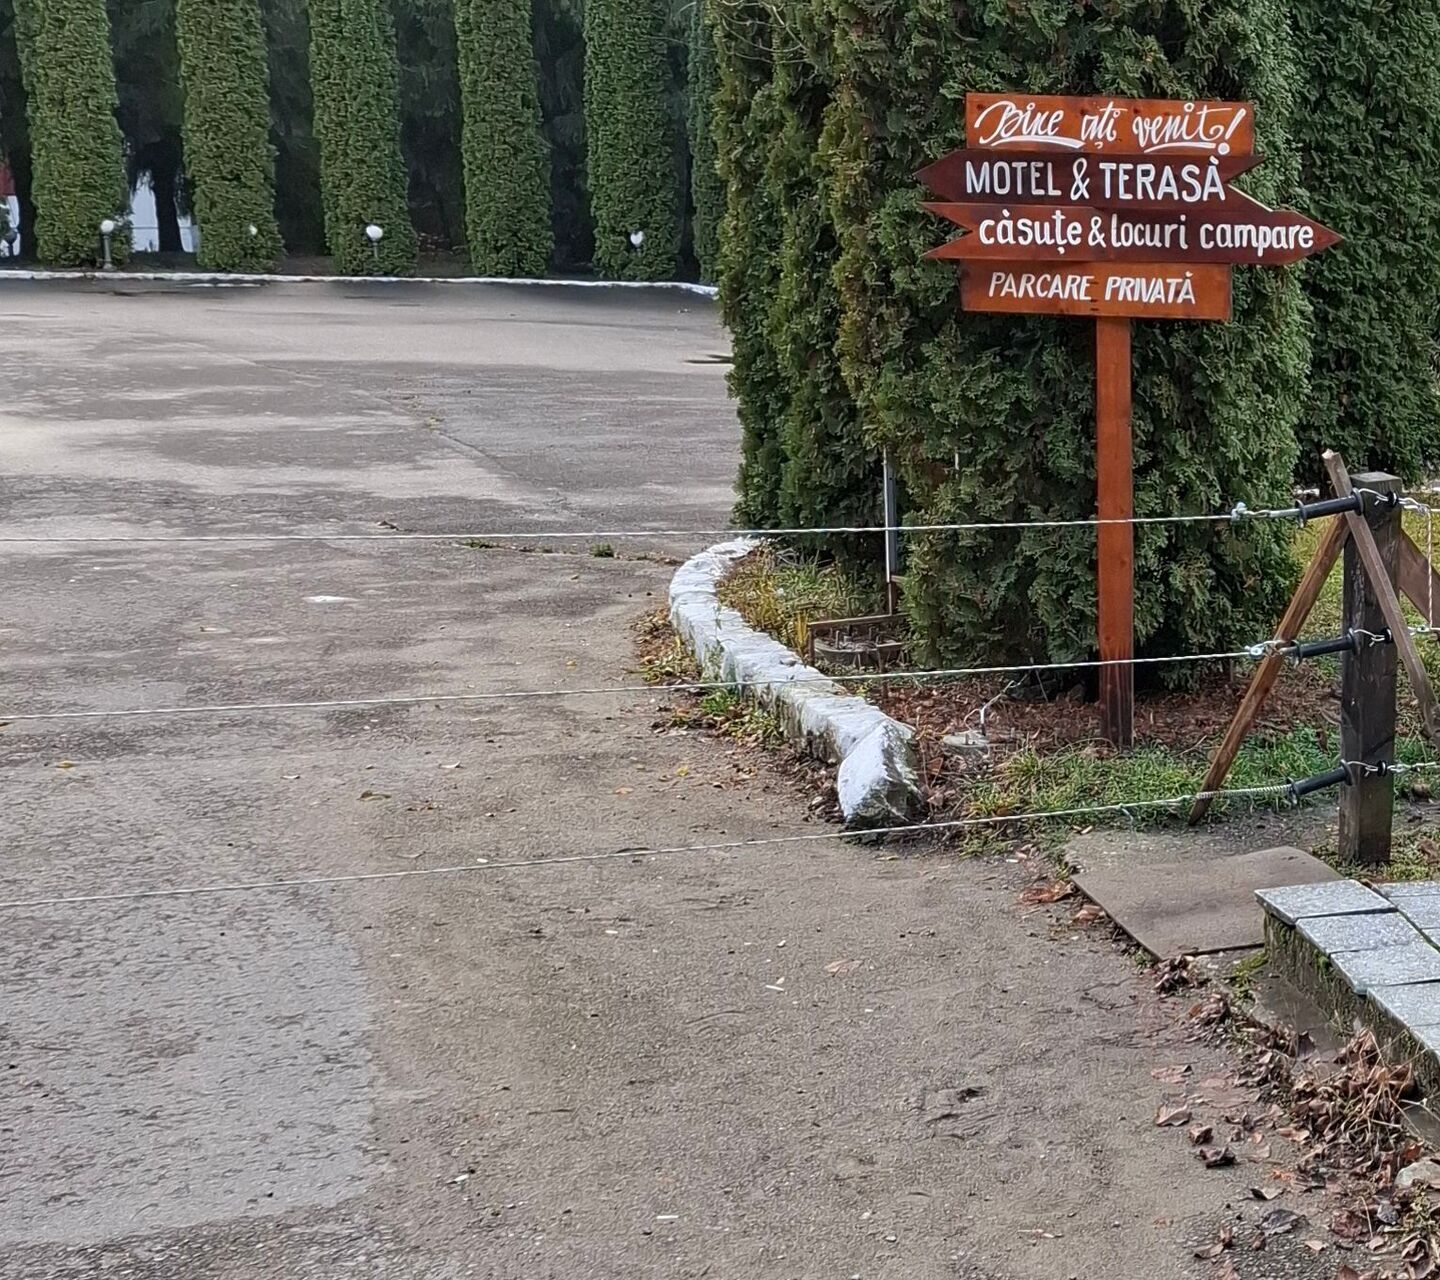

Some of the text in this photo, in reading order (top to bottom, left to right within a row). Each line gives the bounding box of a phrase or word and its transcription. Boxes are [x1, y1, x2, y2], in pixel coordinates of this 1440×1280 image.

[974, 100, 1065, 145] Bine
[1132, 102, 1246, 155] venit!
[966, 160, 1061, 197] MOTEL
[1070, 157, 1090, 201] &
[1087, 216, 1107, 248] &
[1110, 213, 1188, 250] locuri
[1200, 223, 1314, 257] campare
[988, 270, 1196, 305] PARCARE PRIVATĂ
